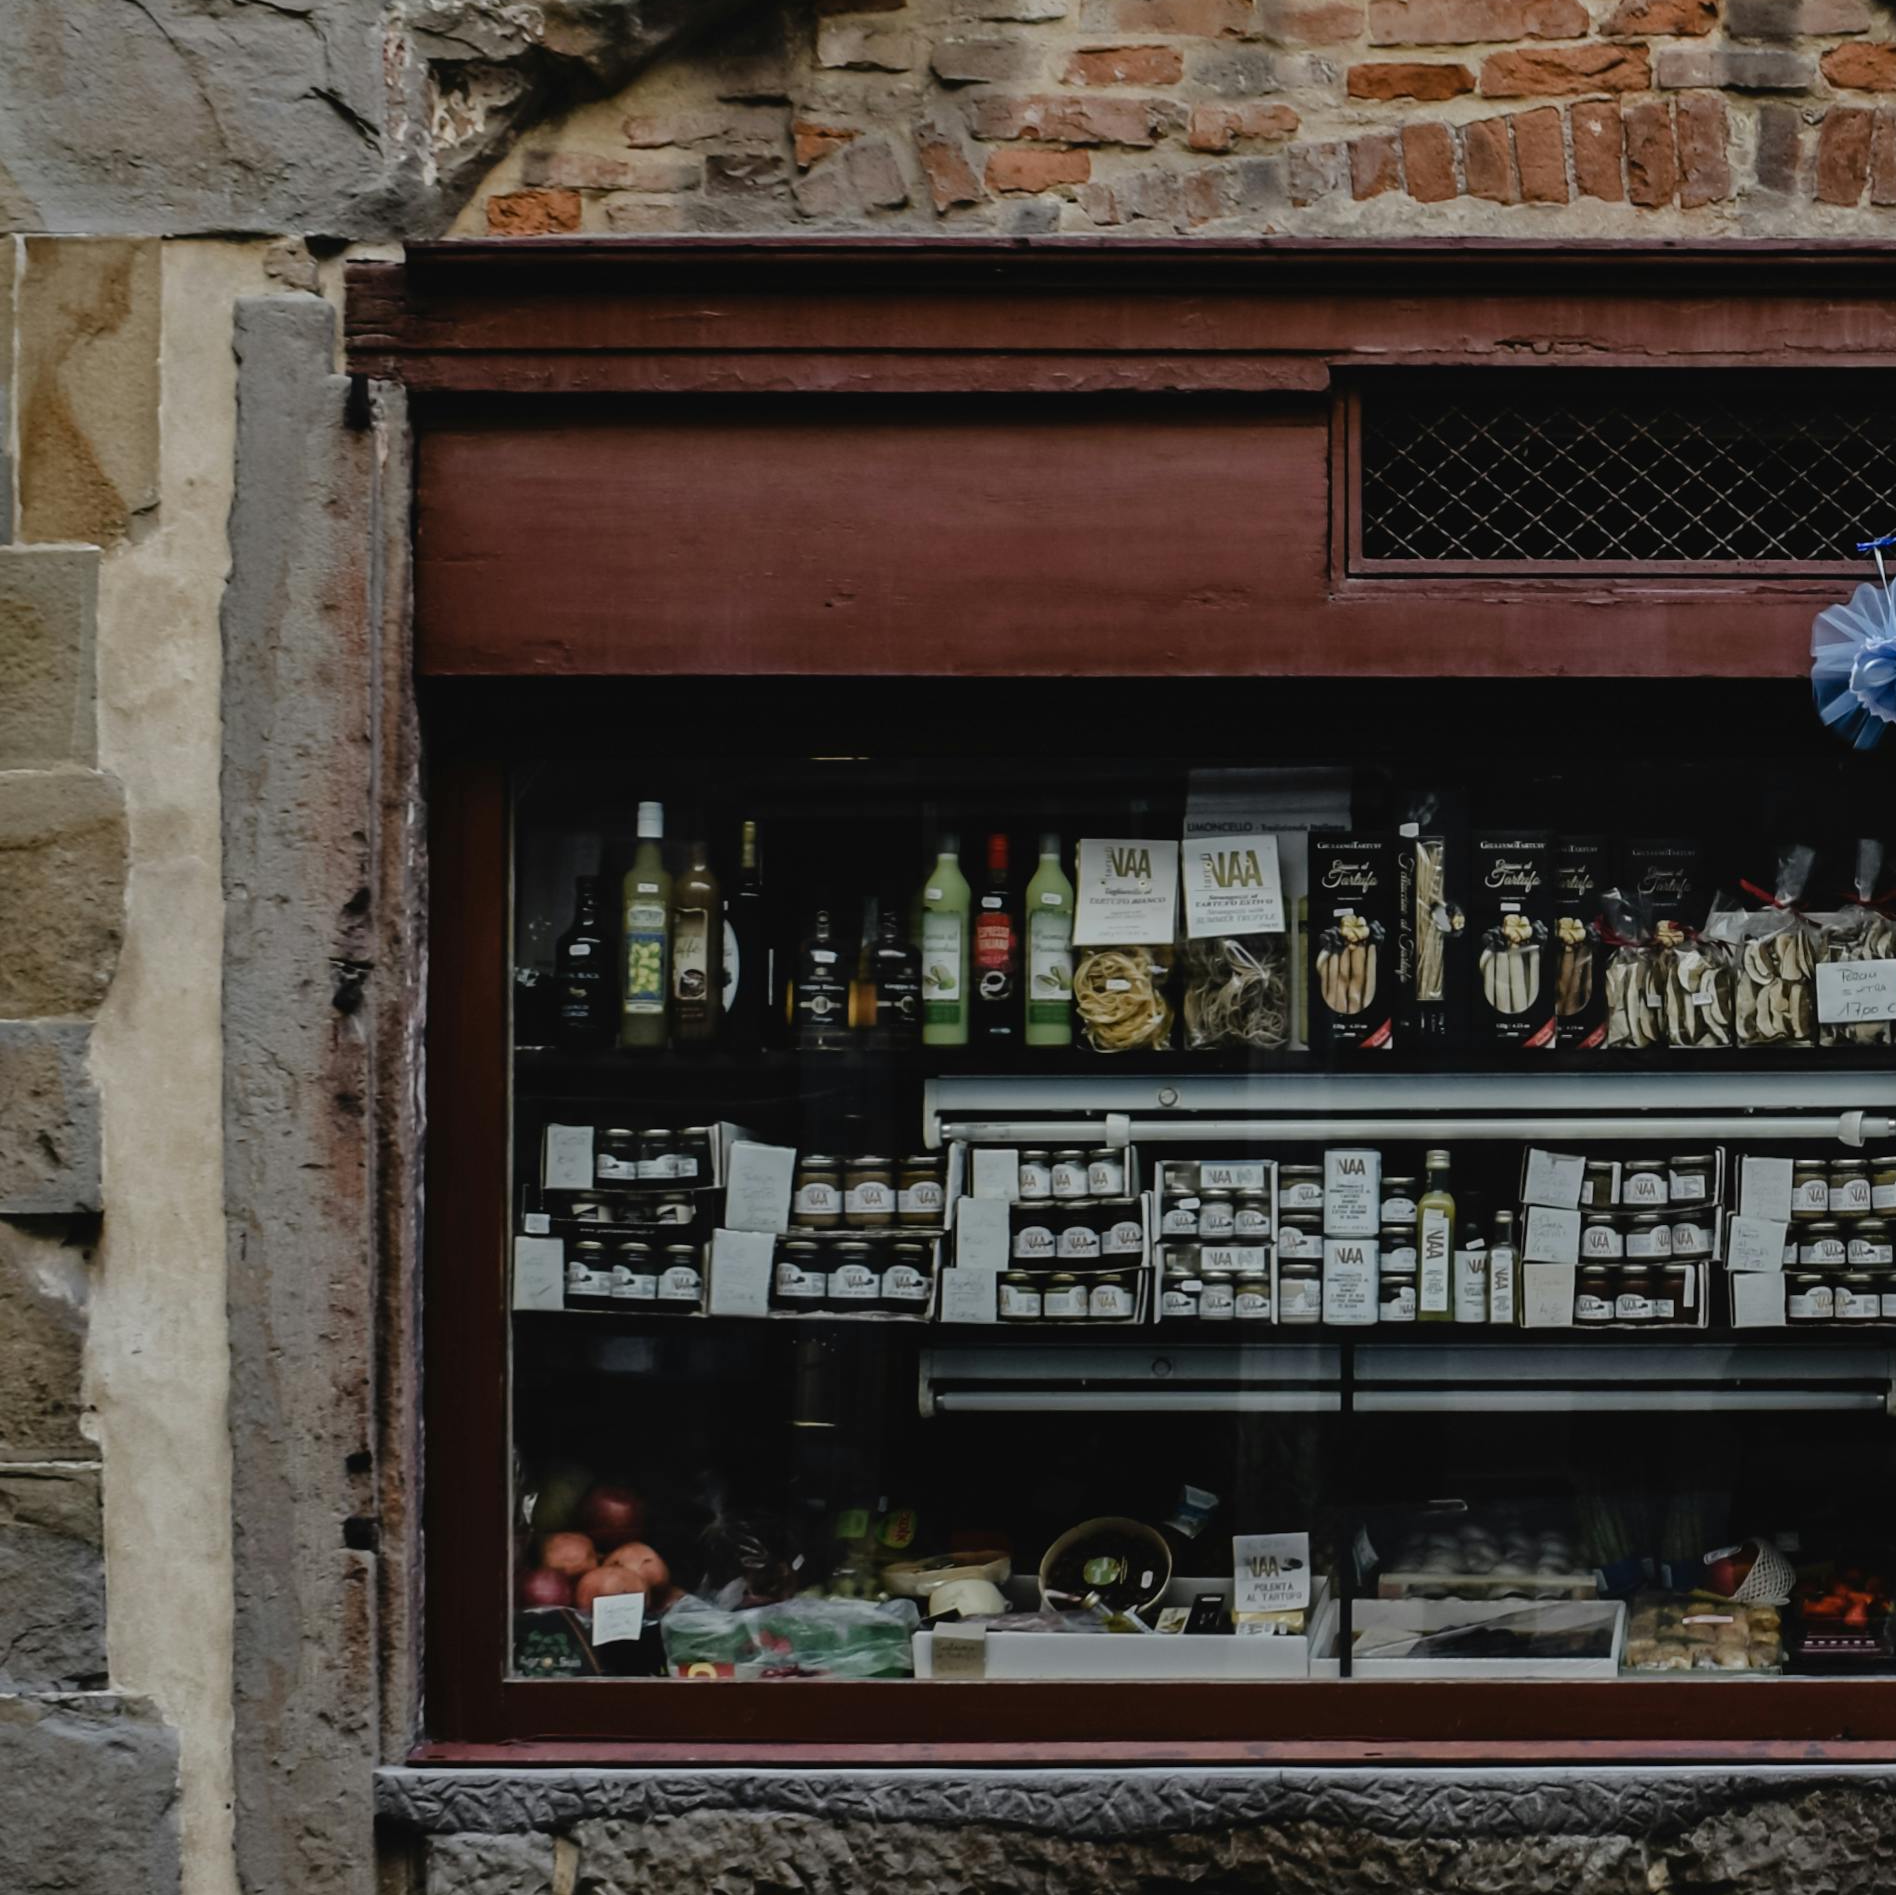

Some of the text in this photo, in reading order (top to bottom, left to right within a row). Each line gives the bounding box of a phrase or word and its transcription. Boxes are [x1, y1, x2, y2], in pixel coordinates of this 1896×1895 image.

[1187, 822, 1253, 832] LIMONCELLO
[1321, 868, 1378, 893] Tartufo
[1484, 867, 1542, 893] Tartufo
[1254, 1581, 1294, 1592] POLENTA
[1263, 1592, 1303, 1600] TARTUFO
